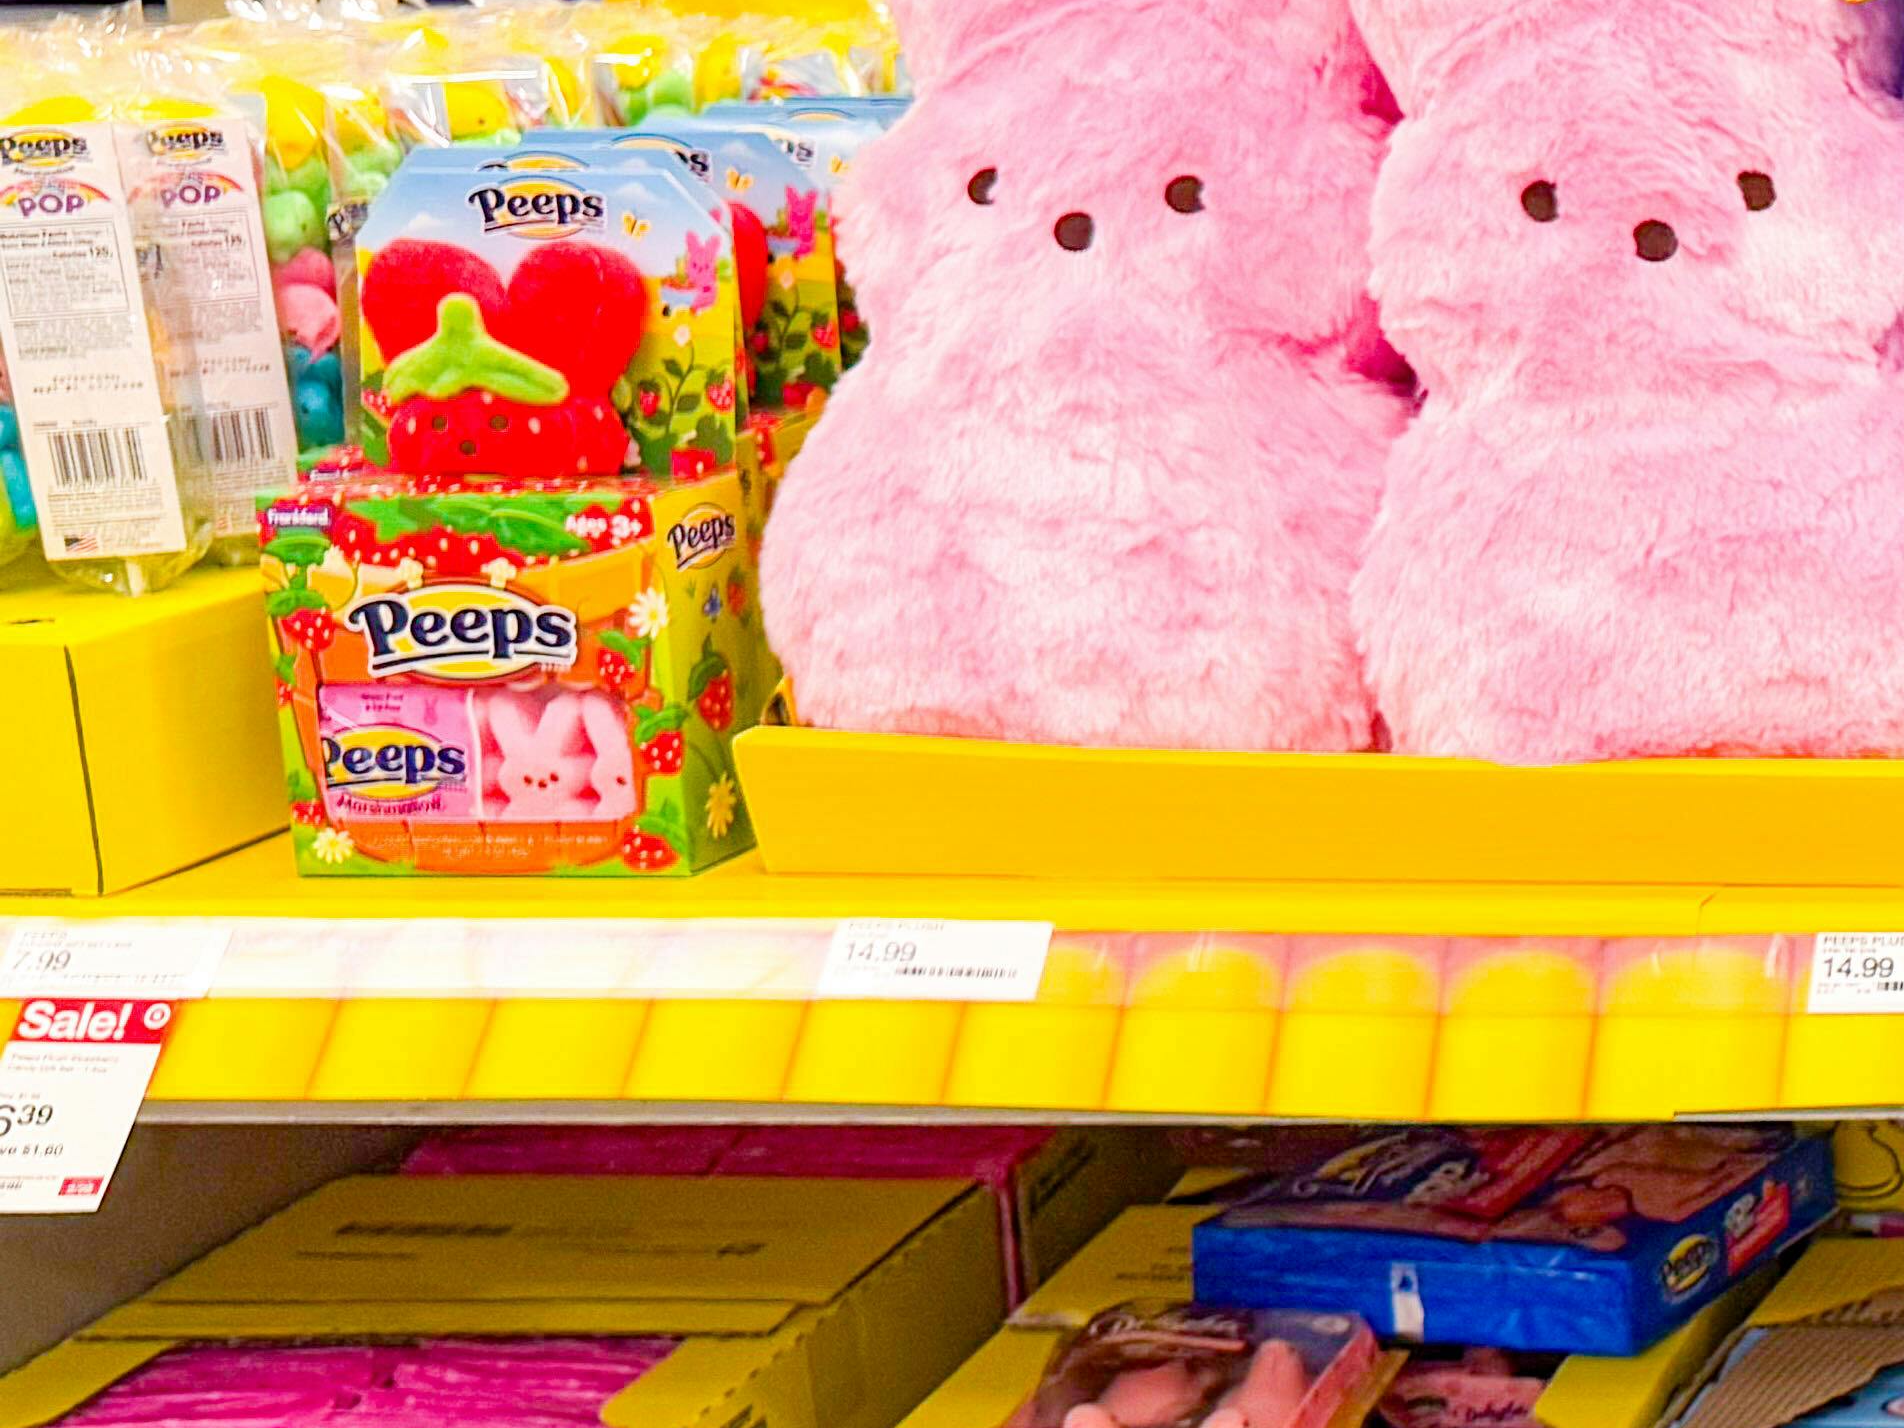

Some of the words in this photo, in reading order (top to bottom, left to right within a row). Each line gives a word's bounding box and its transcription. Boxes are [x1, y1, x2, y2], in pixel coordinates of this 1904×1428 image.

[18, 193, 85, 218] POP
[469, 187, 605, 229] Peeps
[350, 599, 573, 667] Peeps
[12, 948, 72, 972] 7.99
[846, 941, 918, 963] 14.99
[1823, 956, 1895, 979] 14.99
[18, 1000, 133, 1040] Sale!
